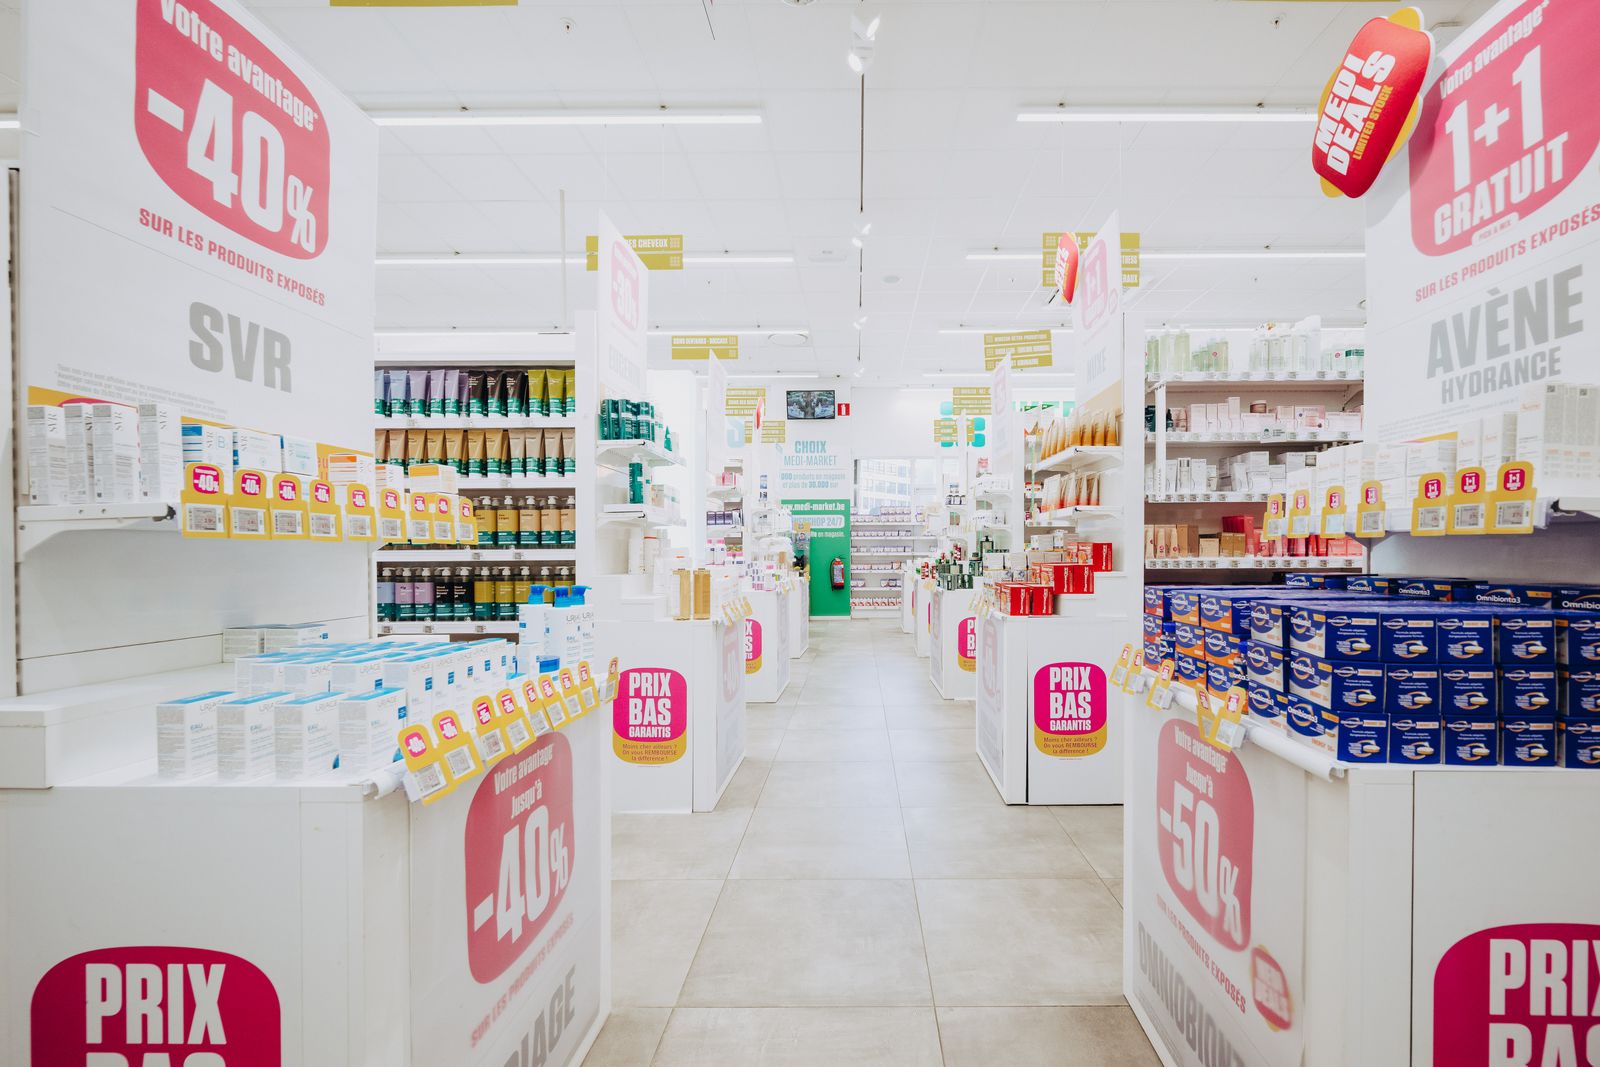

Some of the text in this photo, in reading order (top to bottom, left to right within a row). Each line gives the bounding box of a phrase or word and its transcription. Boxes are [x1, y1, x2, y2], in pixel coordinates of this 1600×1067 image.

[160, 0, 223, 62] Votre
[1315, 53, 1365, 155] MEDI
[1369, 85, 1393, 120] STOCK
[1440, 60, 1472, 99] Votre
[1326, 50, 1396, 176] DEALS
[1445, 45, 1543, 192] 1+1
[1352, 121, 1374, 160] LIMITED
[147, 78, 316, 254] -40%
[1434, 131, 1568, 246] GRATUIT
[139, 207, 325, 306] SUR LES PRODUITS EXPOSÉS
[1415, 203, 1600, 302] SUR LES PRODUITS EXPOSÉS
[1426, 264, 1583, 380] AVÈNE
[188, 301, 292, 393] SVR
[1441, 346, 1561, 405] HYDRANCE
[784, 456, 836, 466] MEDI-MARKET
[795, 441, 826, 453] CHOIX
[827, 517, 842, 527] 24/7
[1476, 594, 1521, 604] Omnibionta3
[629, 672, 672, 697] PRIX
[1049, 667, 1091, 690] PRIX
[629, 698, 672, 726] BAS
[1049, 720, 1092, 731] GARANTIS
[1050, 692, 1091, 719] BAS
[629, 726, 671, 738] GARANTIS
[1174, 725, 1192, 752] Votre
[494, 765, 517, 795] Votre
[474, 804, 569, 944] -40%
[1160, 780, 1242, 946] -50%
[1178, 919, 1210, 970] PRODUITS
[1211, 960, 1246, 1014] EXPOSÉS
[1490, 938, 1600, 1016] PRI
[86, 963, 227, 1044] PRIX
[471, 1013, 490, 1048] SUR
